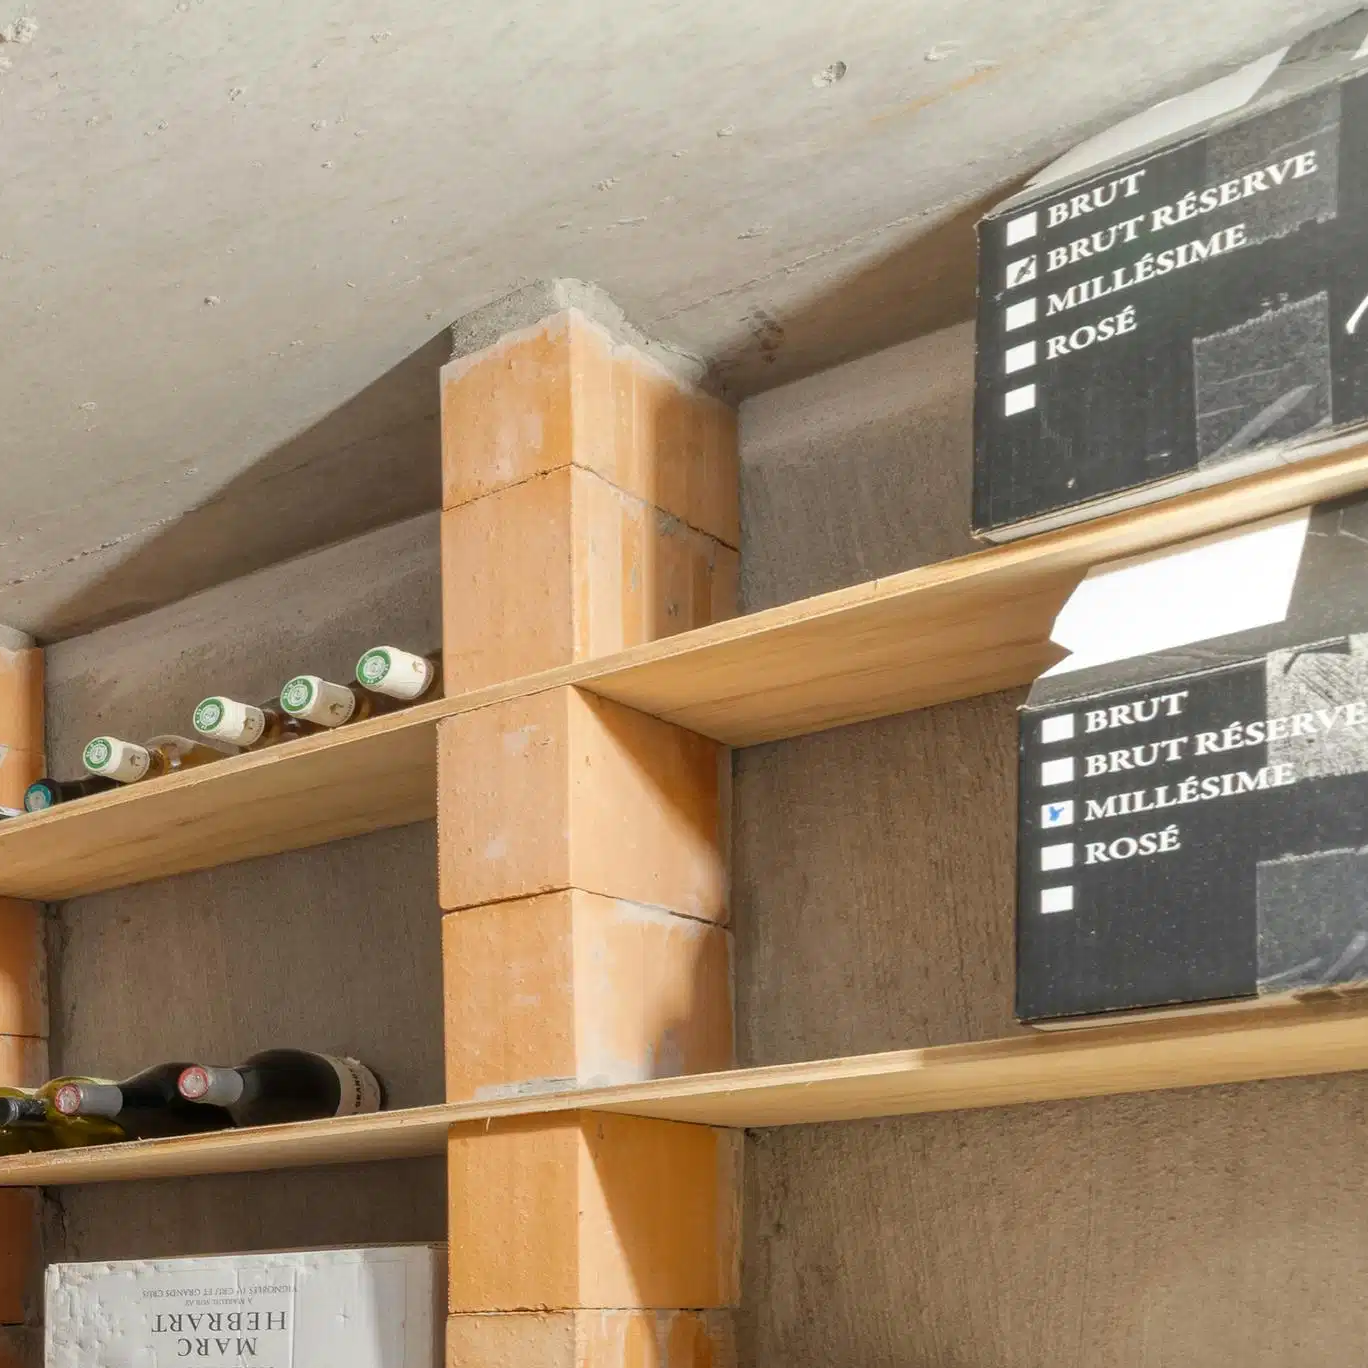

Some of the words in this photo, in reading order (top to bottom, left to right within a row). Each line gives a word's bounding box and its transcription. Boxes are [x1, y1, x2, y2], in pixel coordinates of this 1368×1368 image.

[1046, 169, 1147, 229] BRUT
[1046, 214, 1144, 273] BRUT
[1150, 150, 1320, 232] RÉSERVE
[1046, 223, 1248, 316] MILLÉSIME
[1046, 305, 1138, 360] ROSÉ
[1084, 691, 1189, 733] BRUT
[1084, 736, 1189, 777] BRUT
[1194, 702, 1368, 756] RÉSERVE
[1084, 762, 1298, 821] MILLÉSIME
[1084, 824, 1182, 865] ROSÉ
[165, 1288, 201, 1298] GRANDS
[151, 1311, 288, 1333] HEBRART
[177, 1336, 259, 1357] MARC
